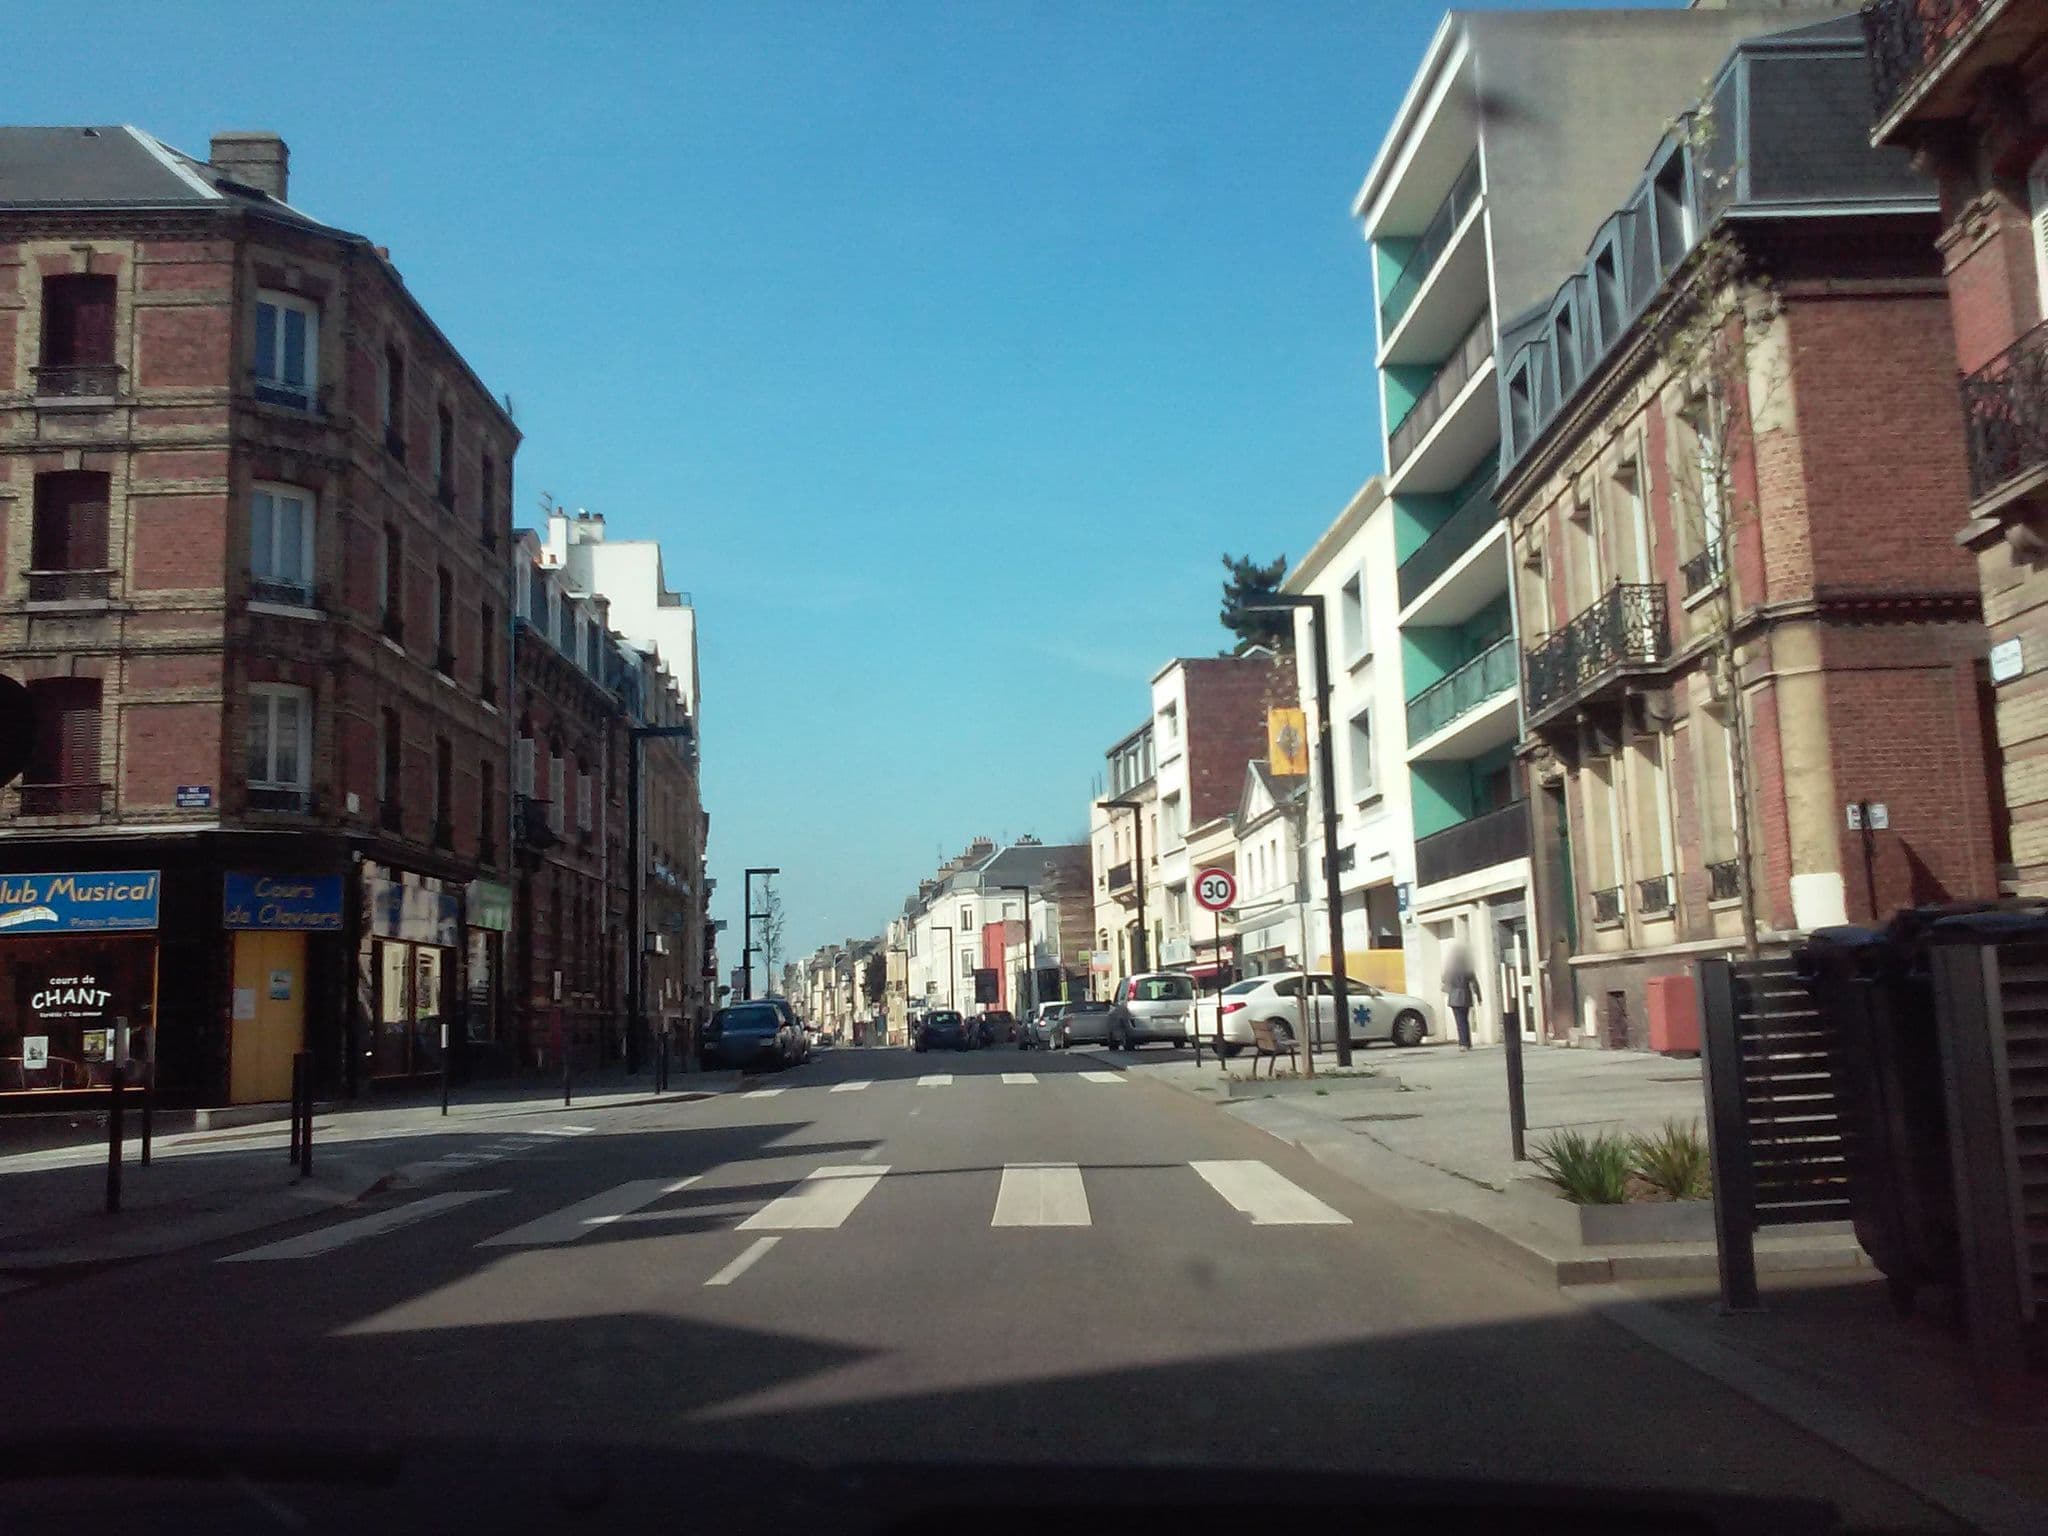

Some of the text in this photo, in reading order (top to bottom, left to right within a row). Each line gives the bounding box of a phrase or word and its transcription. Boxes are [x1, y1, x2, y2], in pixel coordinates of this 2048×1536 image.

[45, 876, 156, 902] Musical
[1203, 880, 1229, 899] 30
[49, 974, 96, 986] cours de
[31, 987, 112, 1010] CHANT
